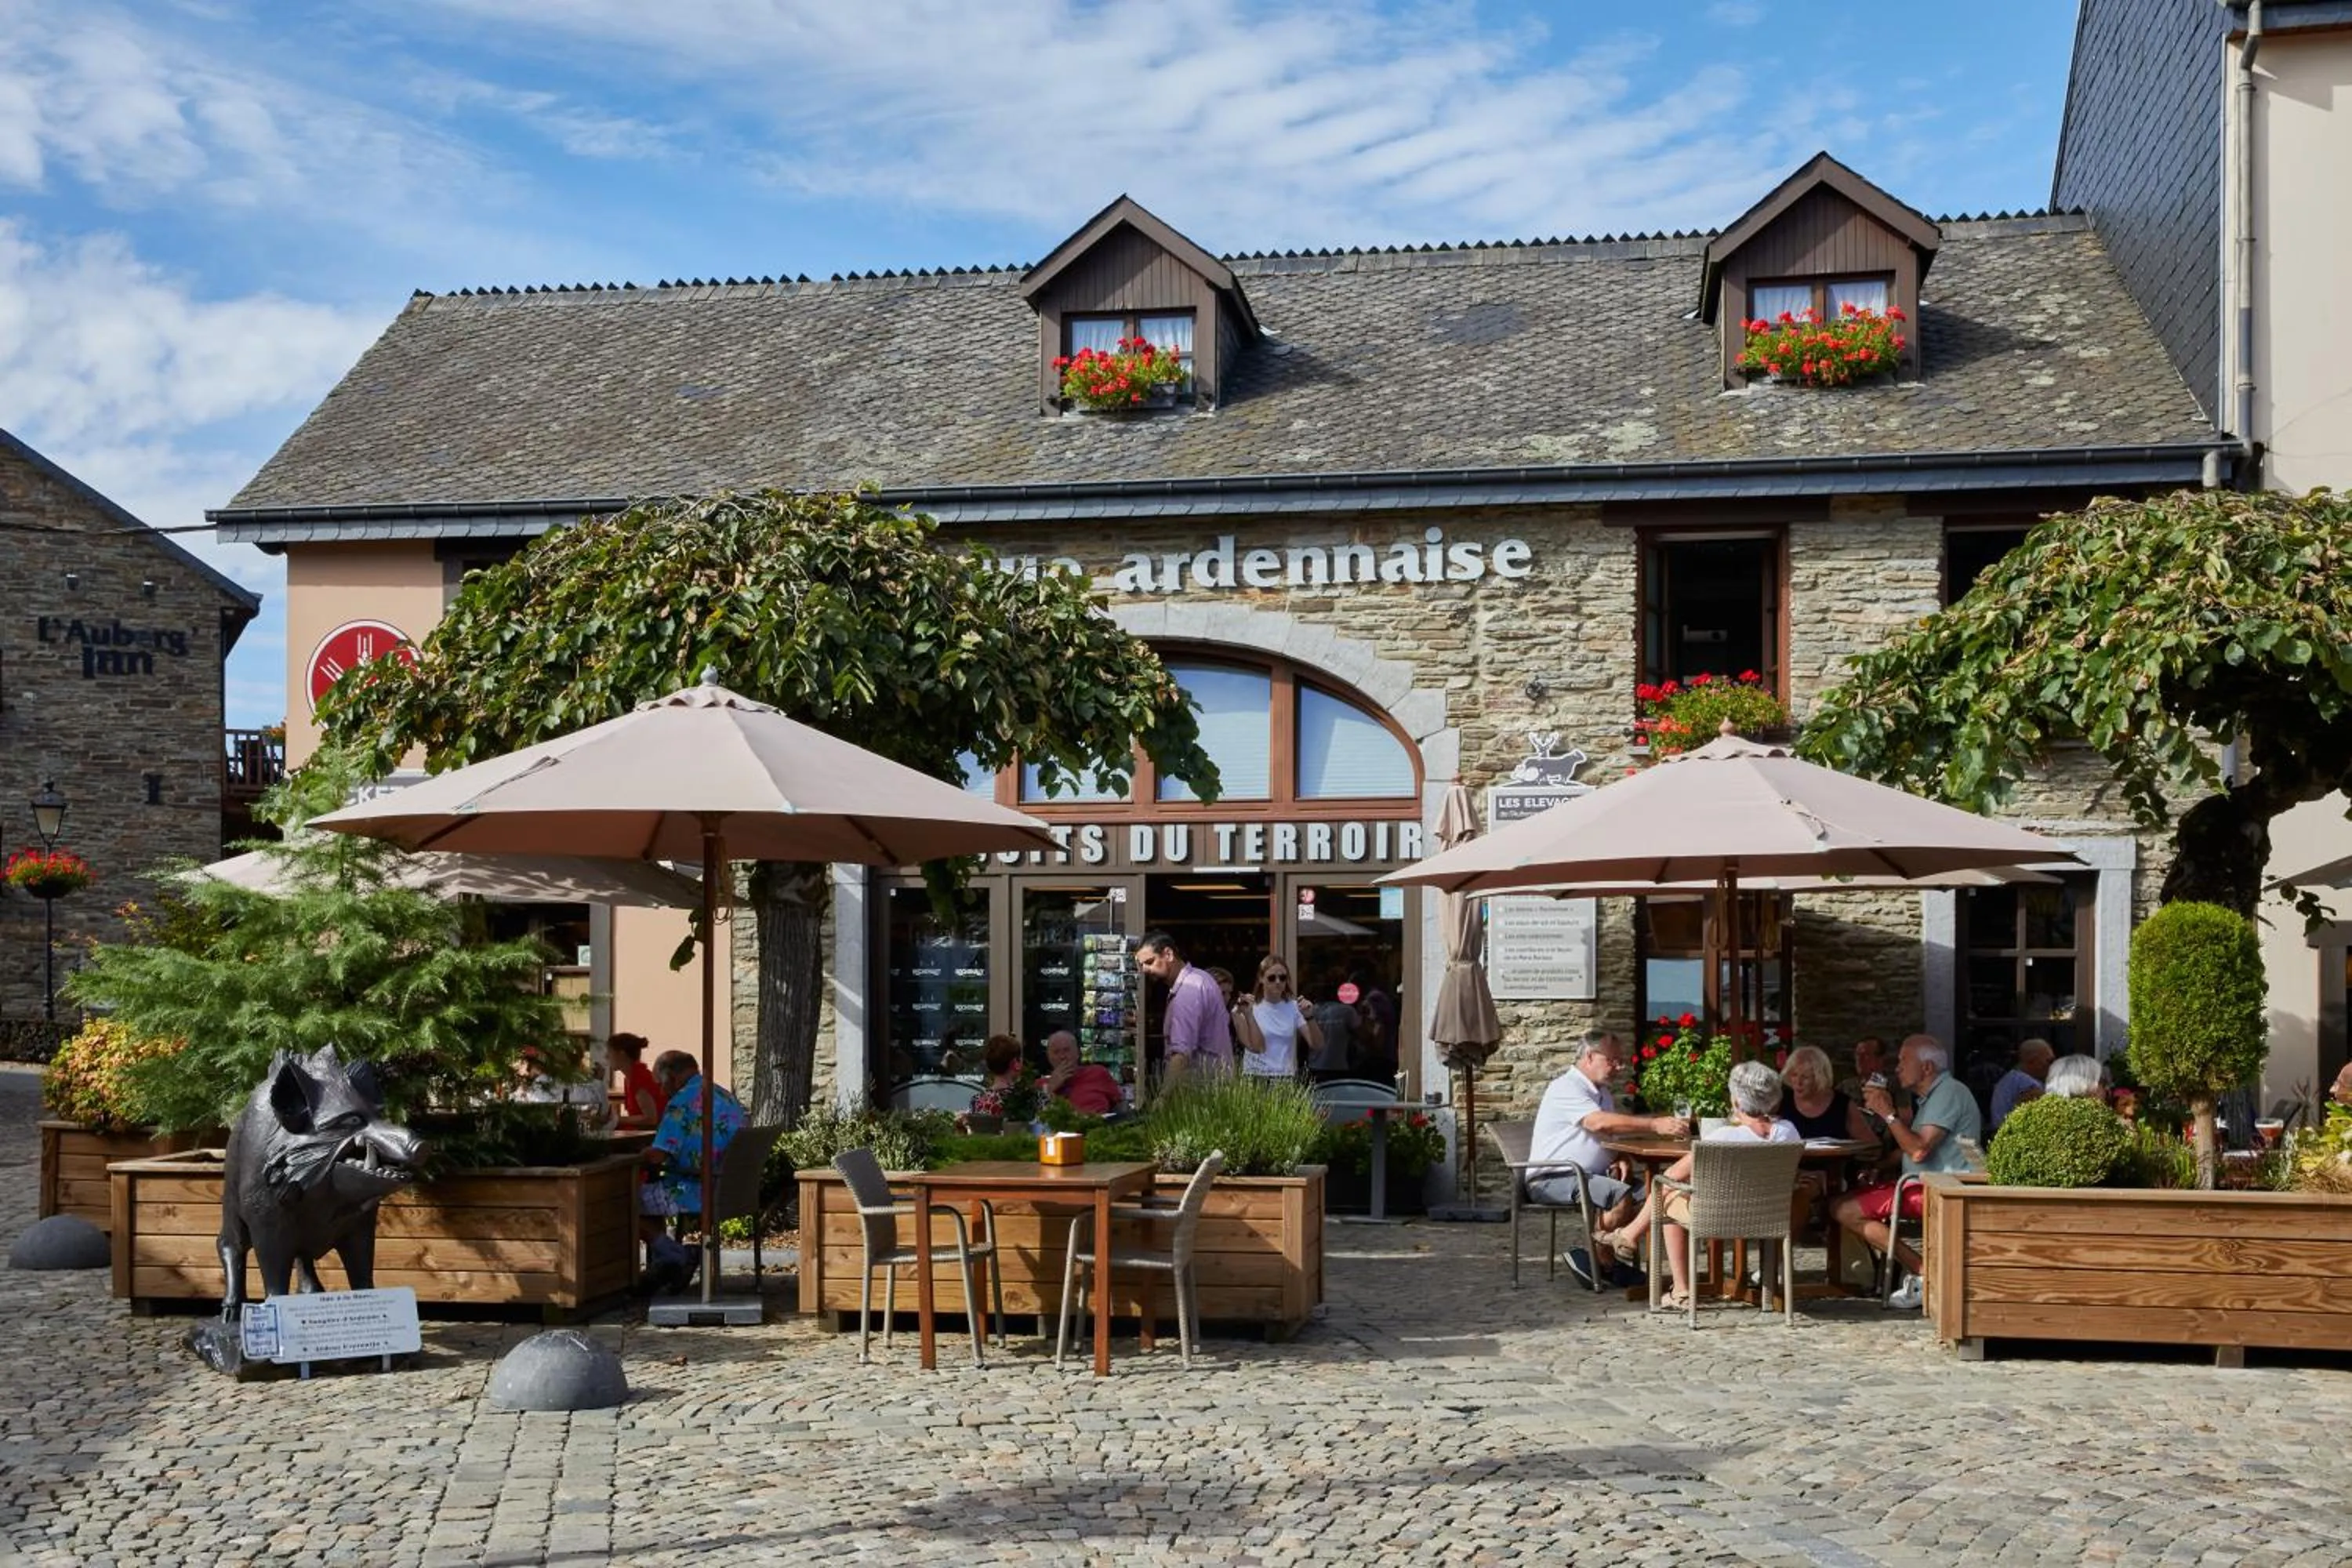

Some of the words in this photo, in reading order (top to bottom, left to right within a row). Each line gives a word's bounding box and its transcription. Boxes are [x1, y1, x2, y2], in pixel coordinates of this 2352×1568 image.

[1113, 526, 1533, 591] ardennaise
[1498, 797, 1520, 808] LES
[1130, 823, 1189, 862] DU
[1214, 821, 1423, 861] TERROIR
